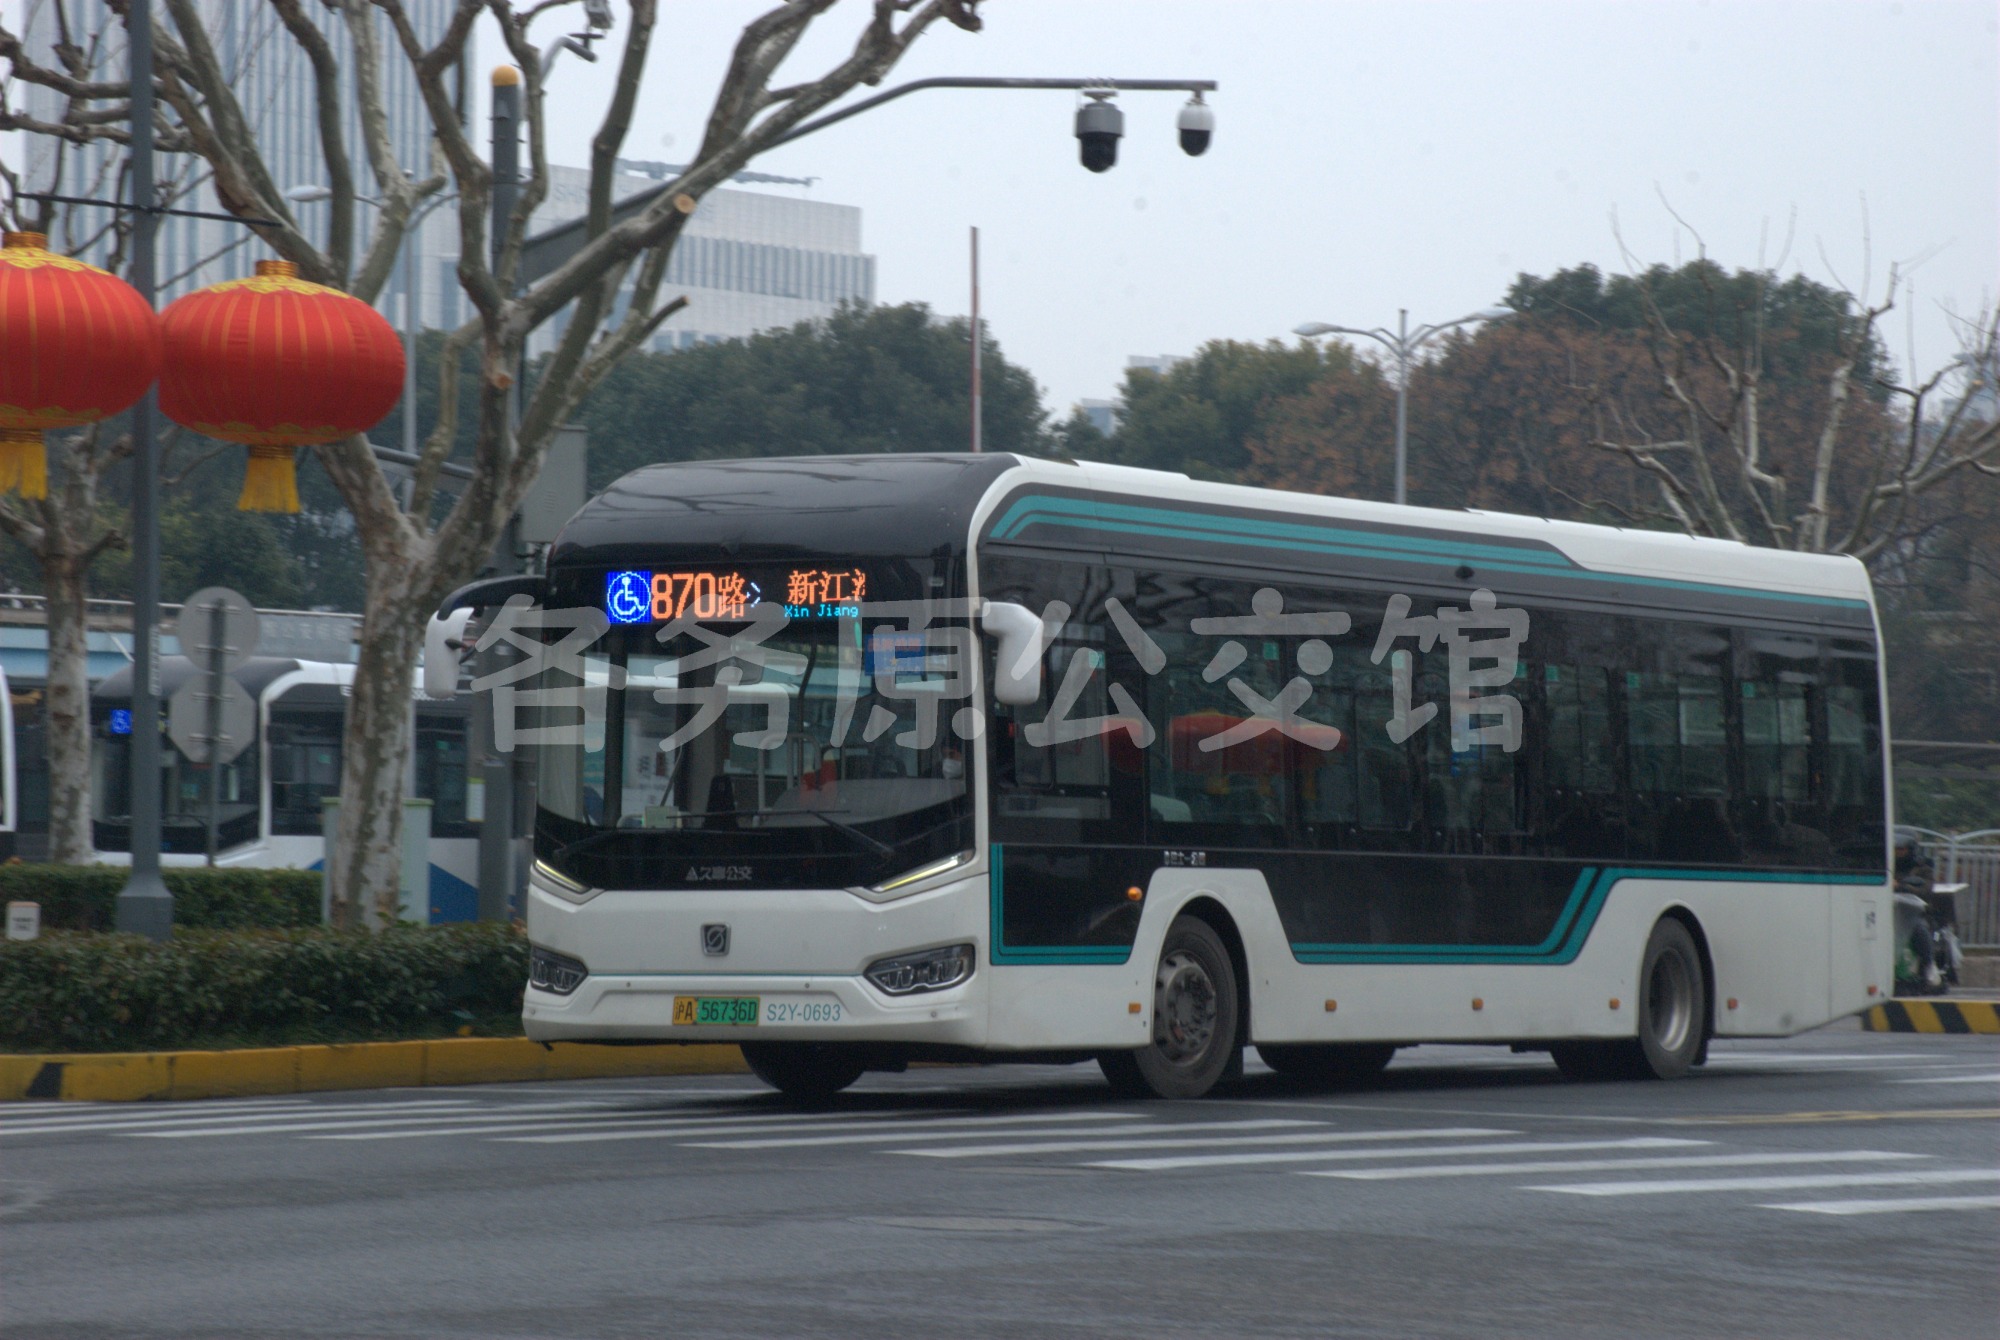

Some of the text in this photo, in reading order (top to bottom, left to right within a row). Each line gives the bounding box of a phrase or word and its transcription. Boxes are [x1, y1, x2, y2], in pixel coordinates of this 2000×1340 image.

[651, 571, 747, 620] 870路
[784, 603, 859, 618] Xin Jiang
[766, 1002, 842, 1022] S2Y-0693
